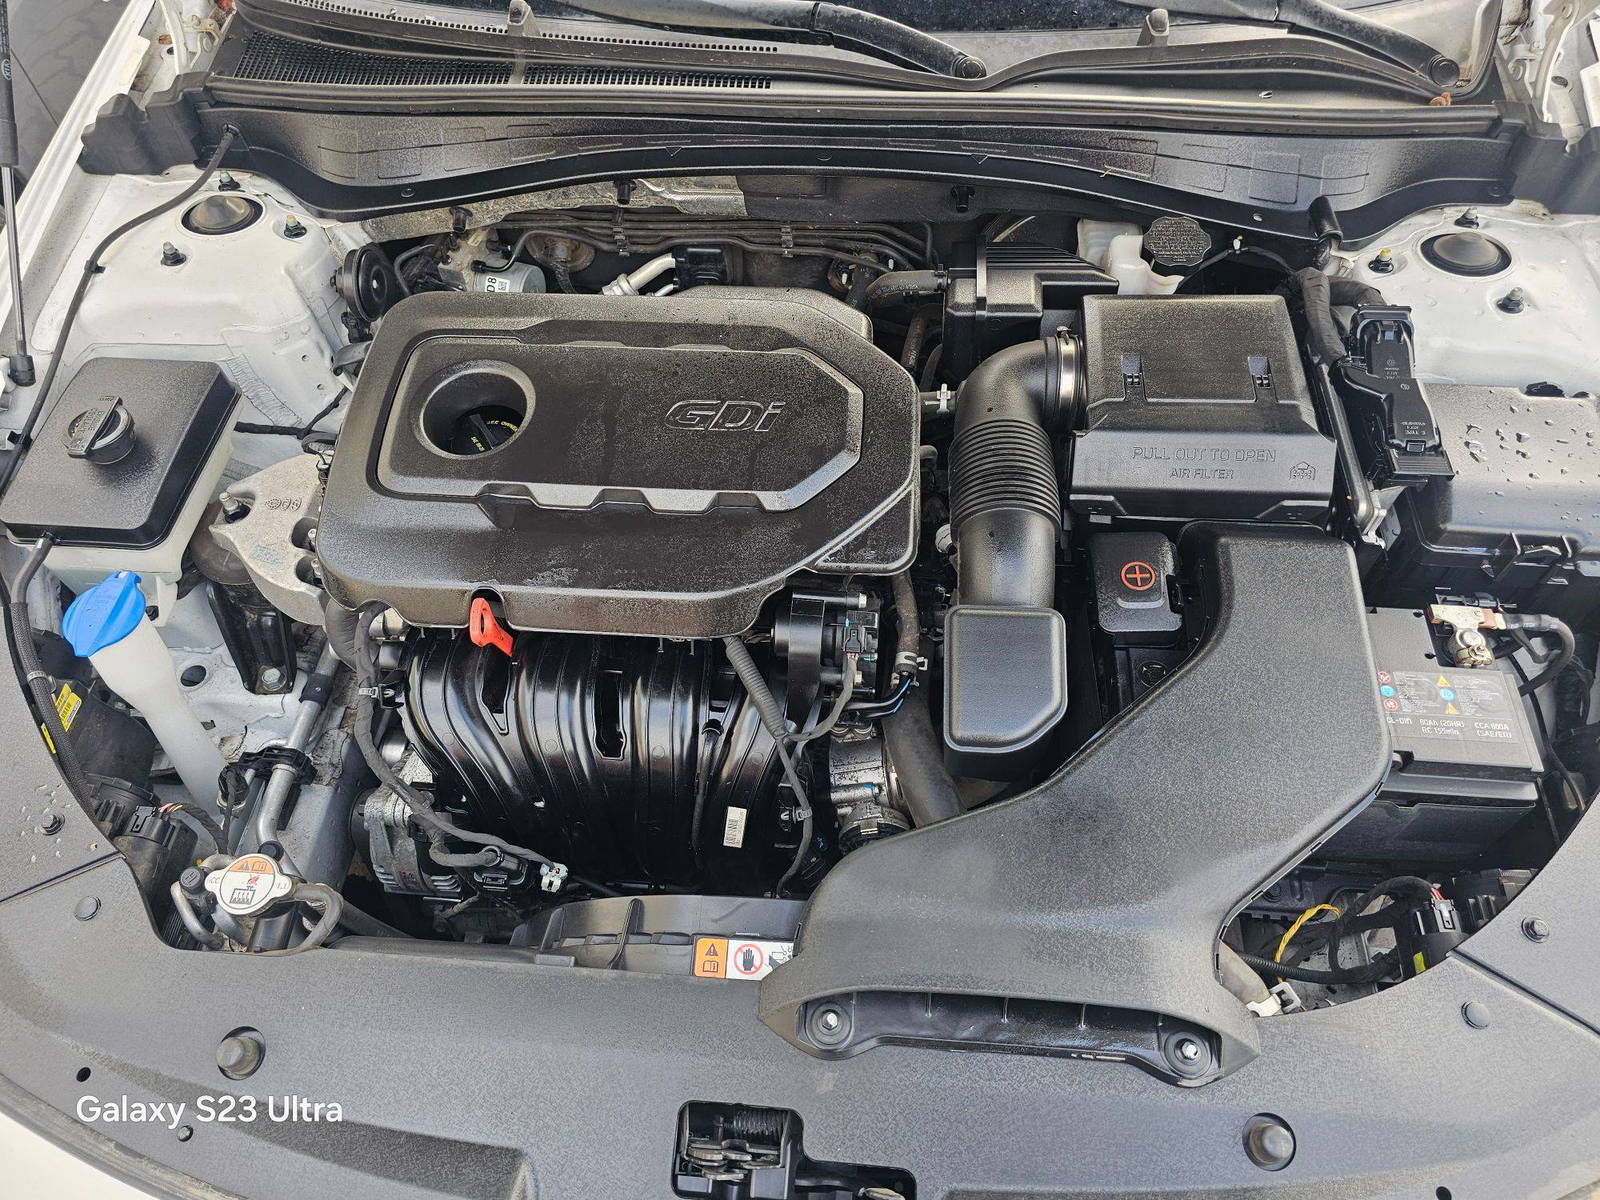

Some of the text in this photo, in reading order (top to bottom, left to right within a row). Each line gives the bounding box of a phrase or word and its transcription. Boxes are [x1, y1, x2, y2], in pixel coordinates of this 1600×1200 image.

[1132, 446, 1277, 463] PULL OUT TO OPEN
[1170, 468, 1234, 480] AIR FILTER
